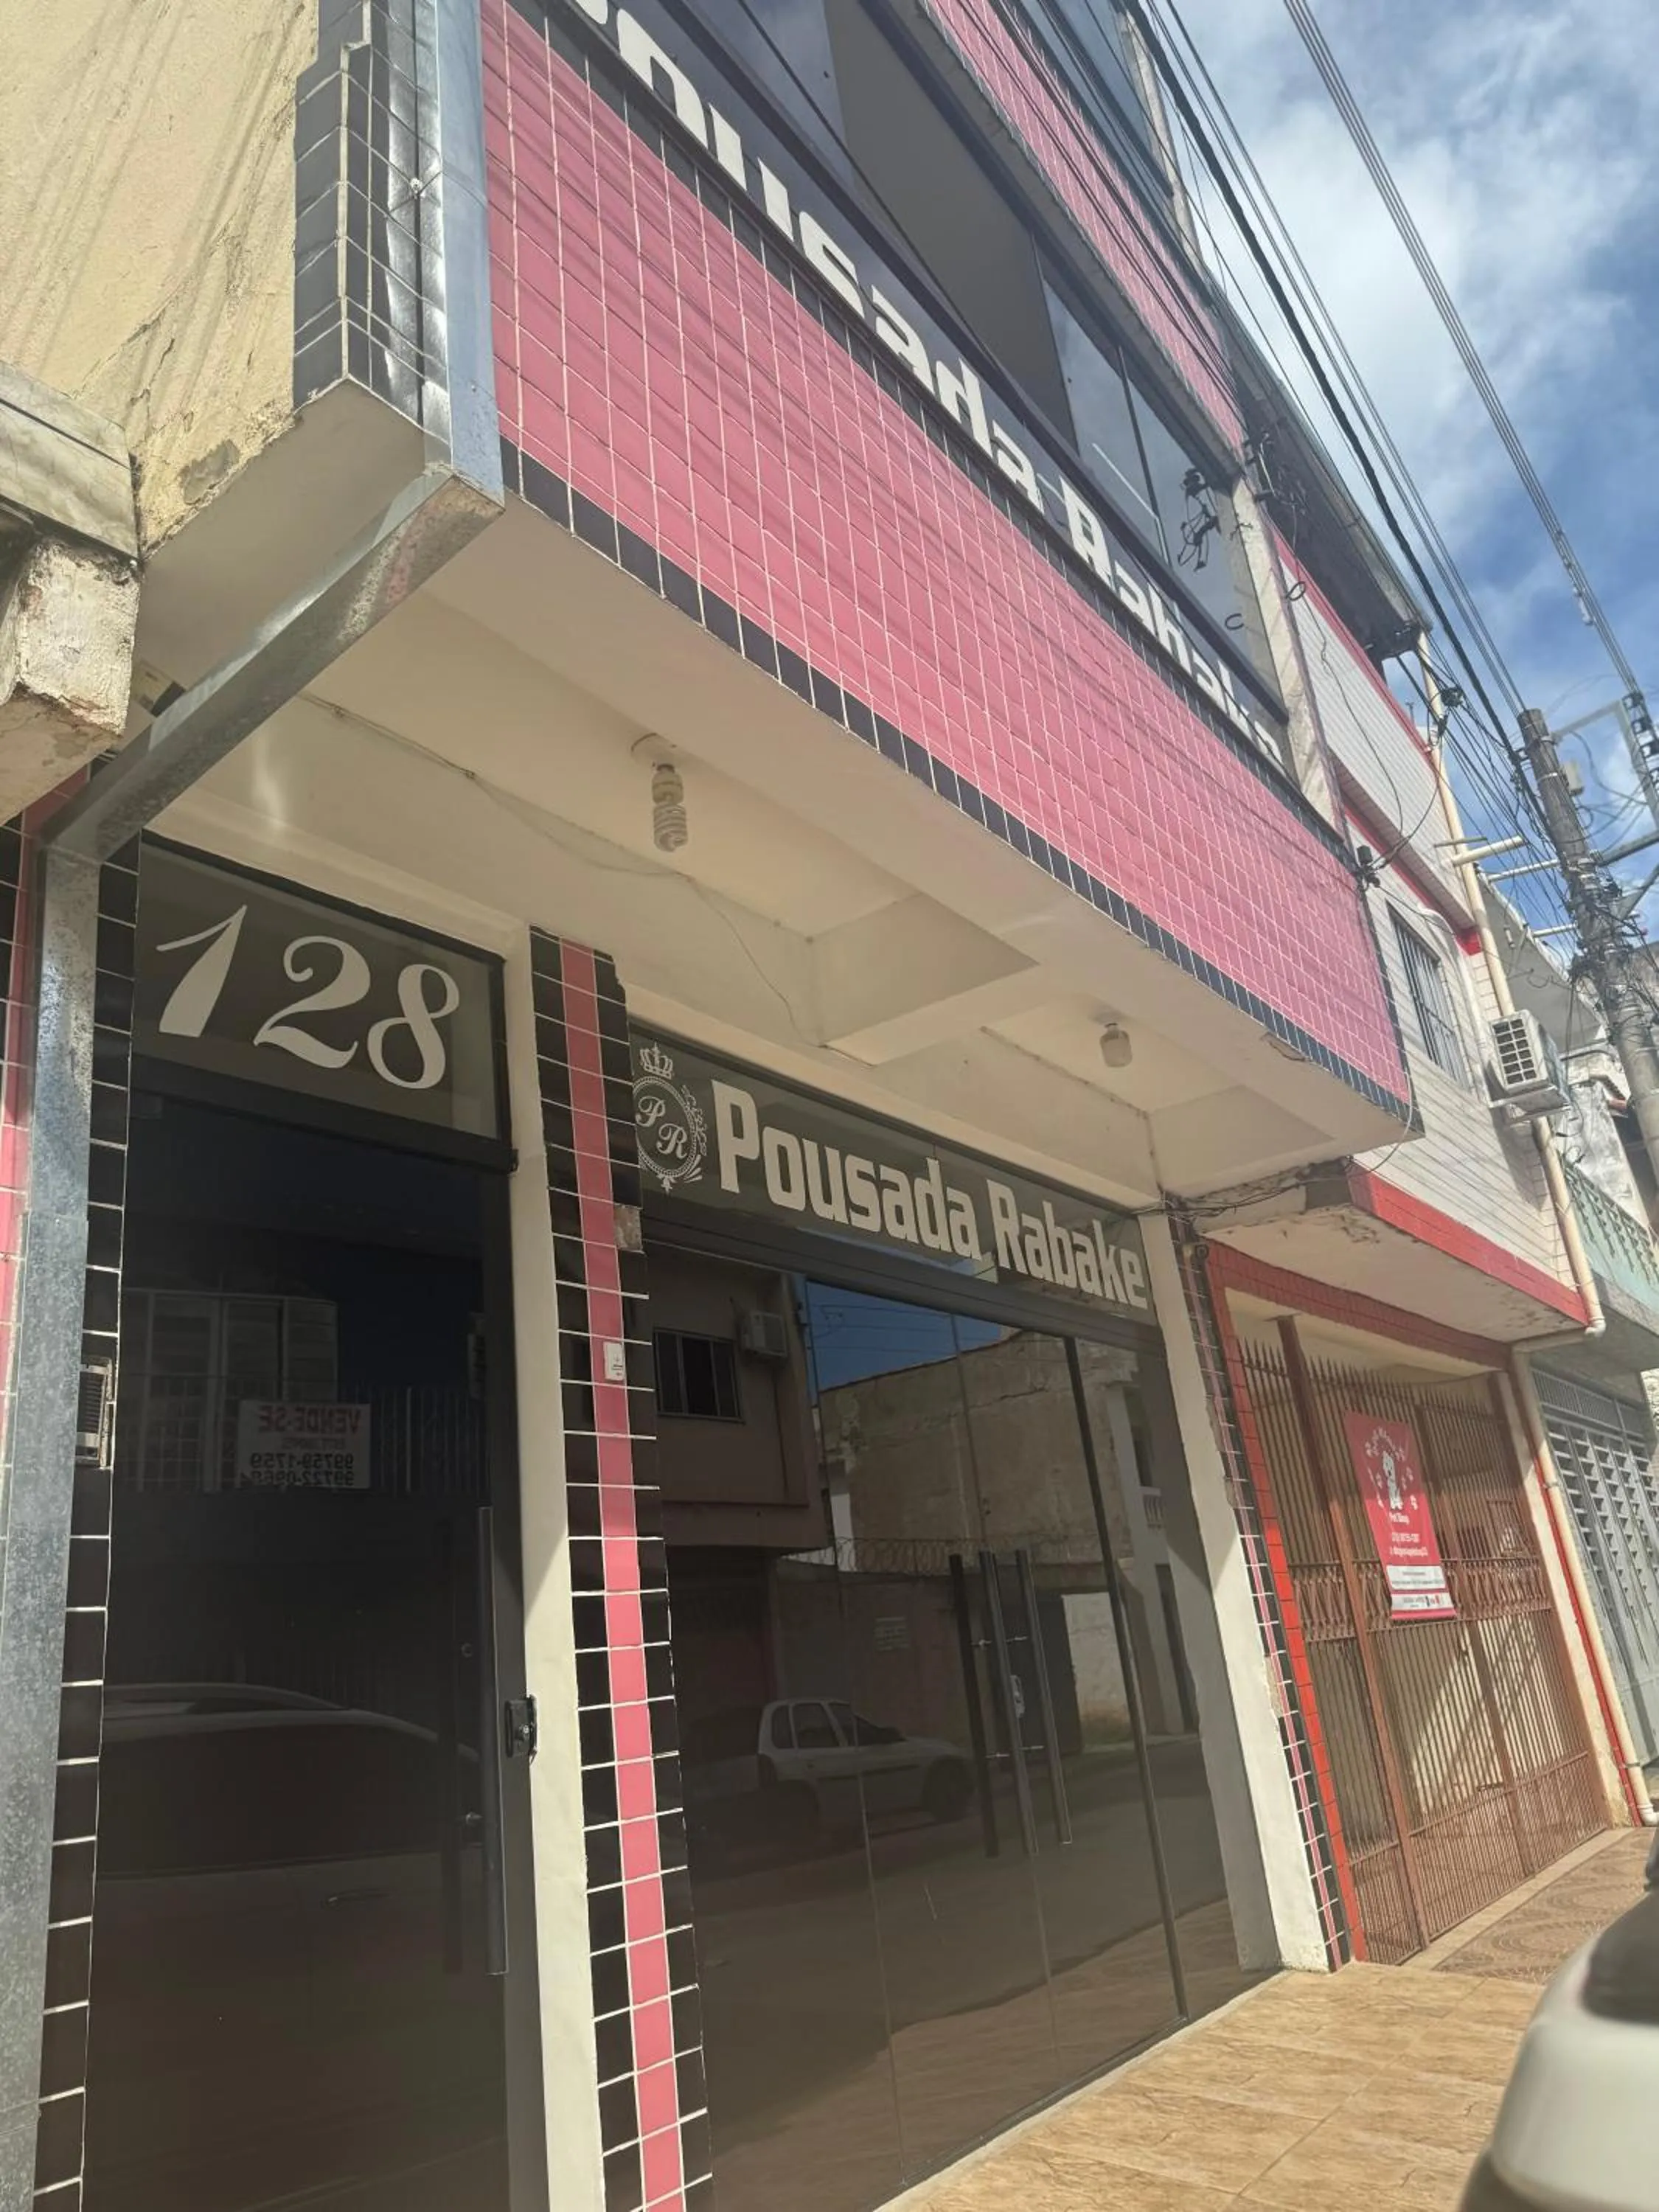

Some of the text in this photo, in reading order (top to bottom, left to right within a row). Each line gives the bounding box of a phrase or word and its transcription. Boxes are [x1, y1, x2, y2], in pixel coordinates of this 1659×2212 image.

[156, 904, 460, 1089] 128
[712, 1079, 1149, 1310] Pousada Rabake
